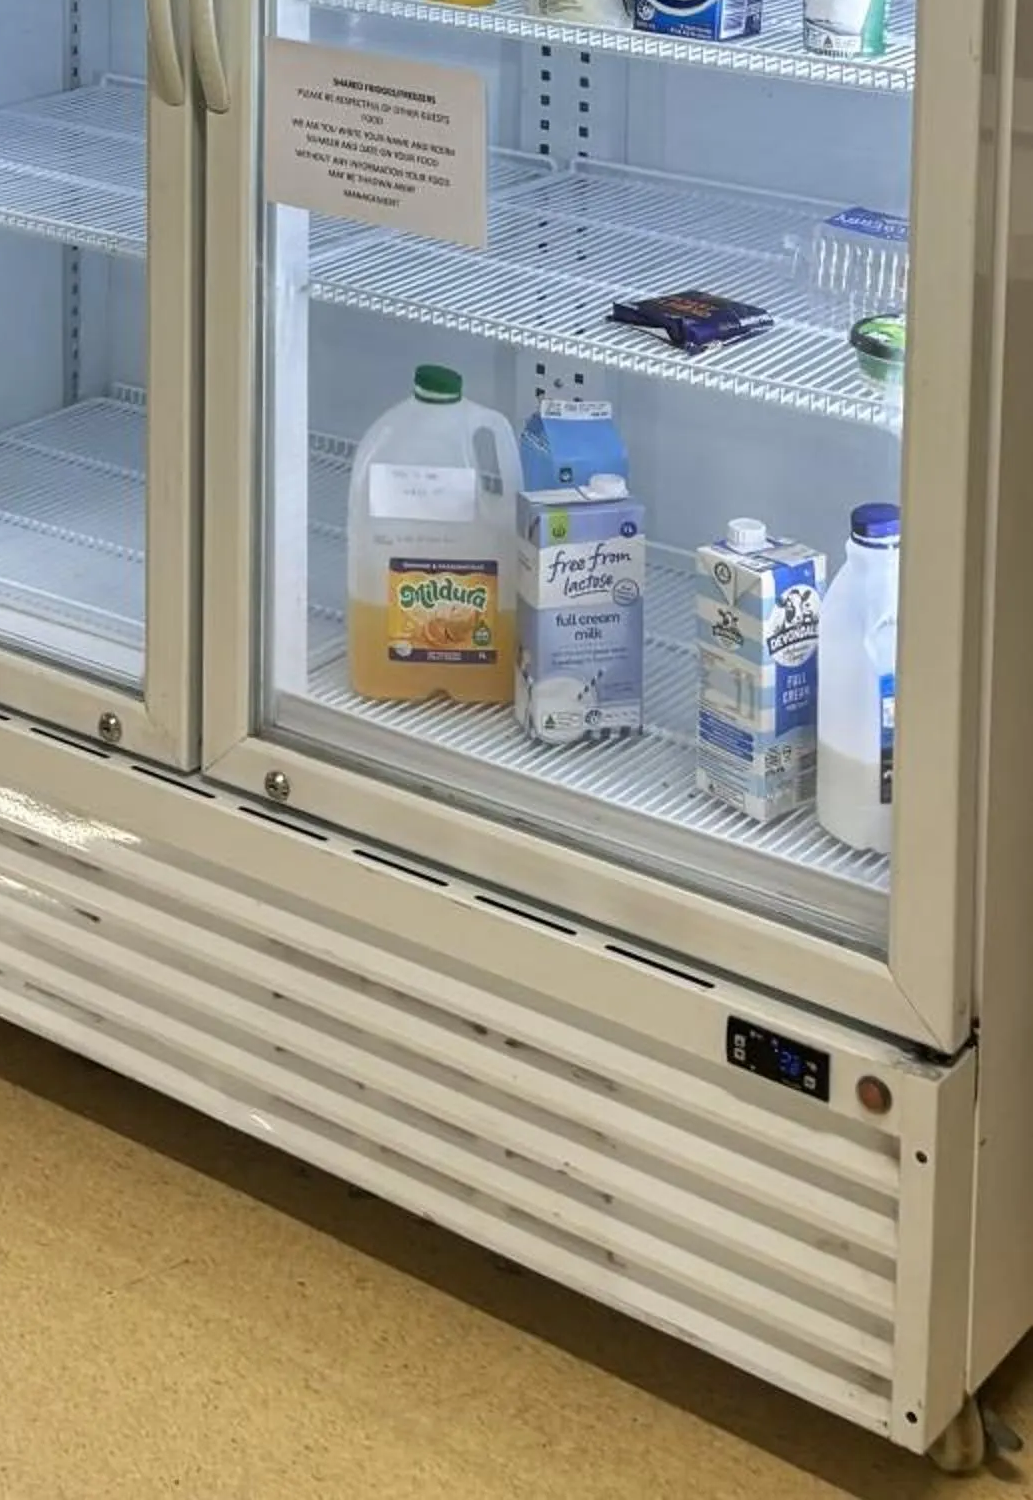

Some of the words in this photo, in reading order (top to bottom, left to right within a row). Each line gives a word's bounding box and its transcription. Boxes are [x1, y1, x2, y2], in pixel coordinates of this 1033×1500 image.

[547, 550, 585, 583] free
[589, 543, 632, 572] from
[564, 573, 614, 596] lactose
[555, 613, 577, 627] full
[578, 612, 620, 625] cream
[574, 627, 603, 641] milk
[770, 624, 818, 651] DEVONDAL
